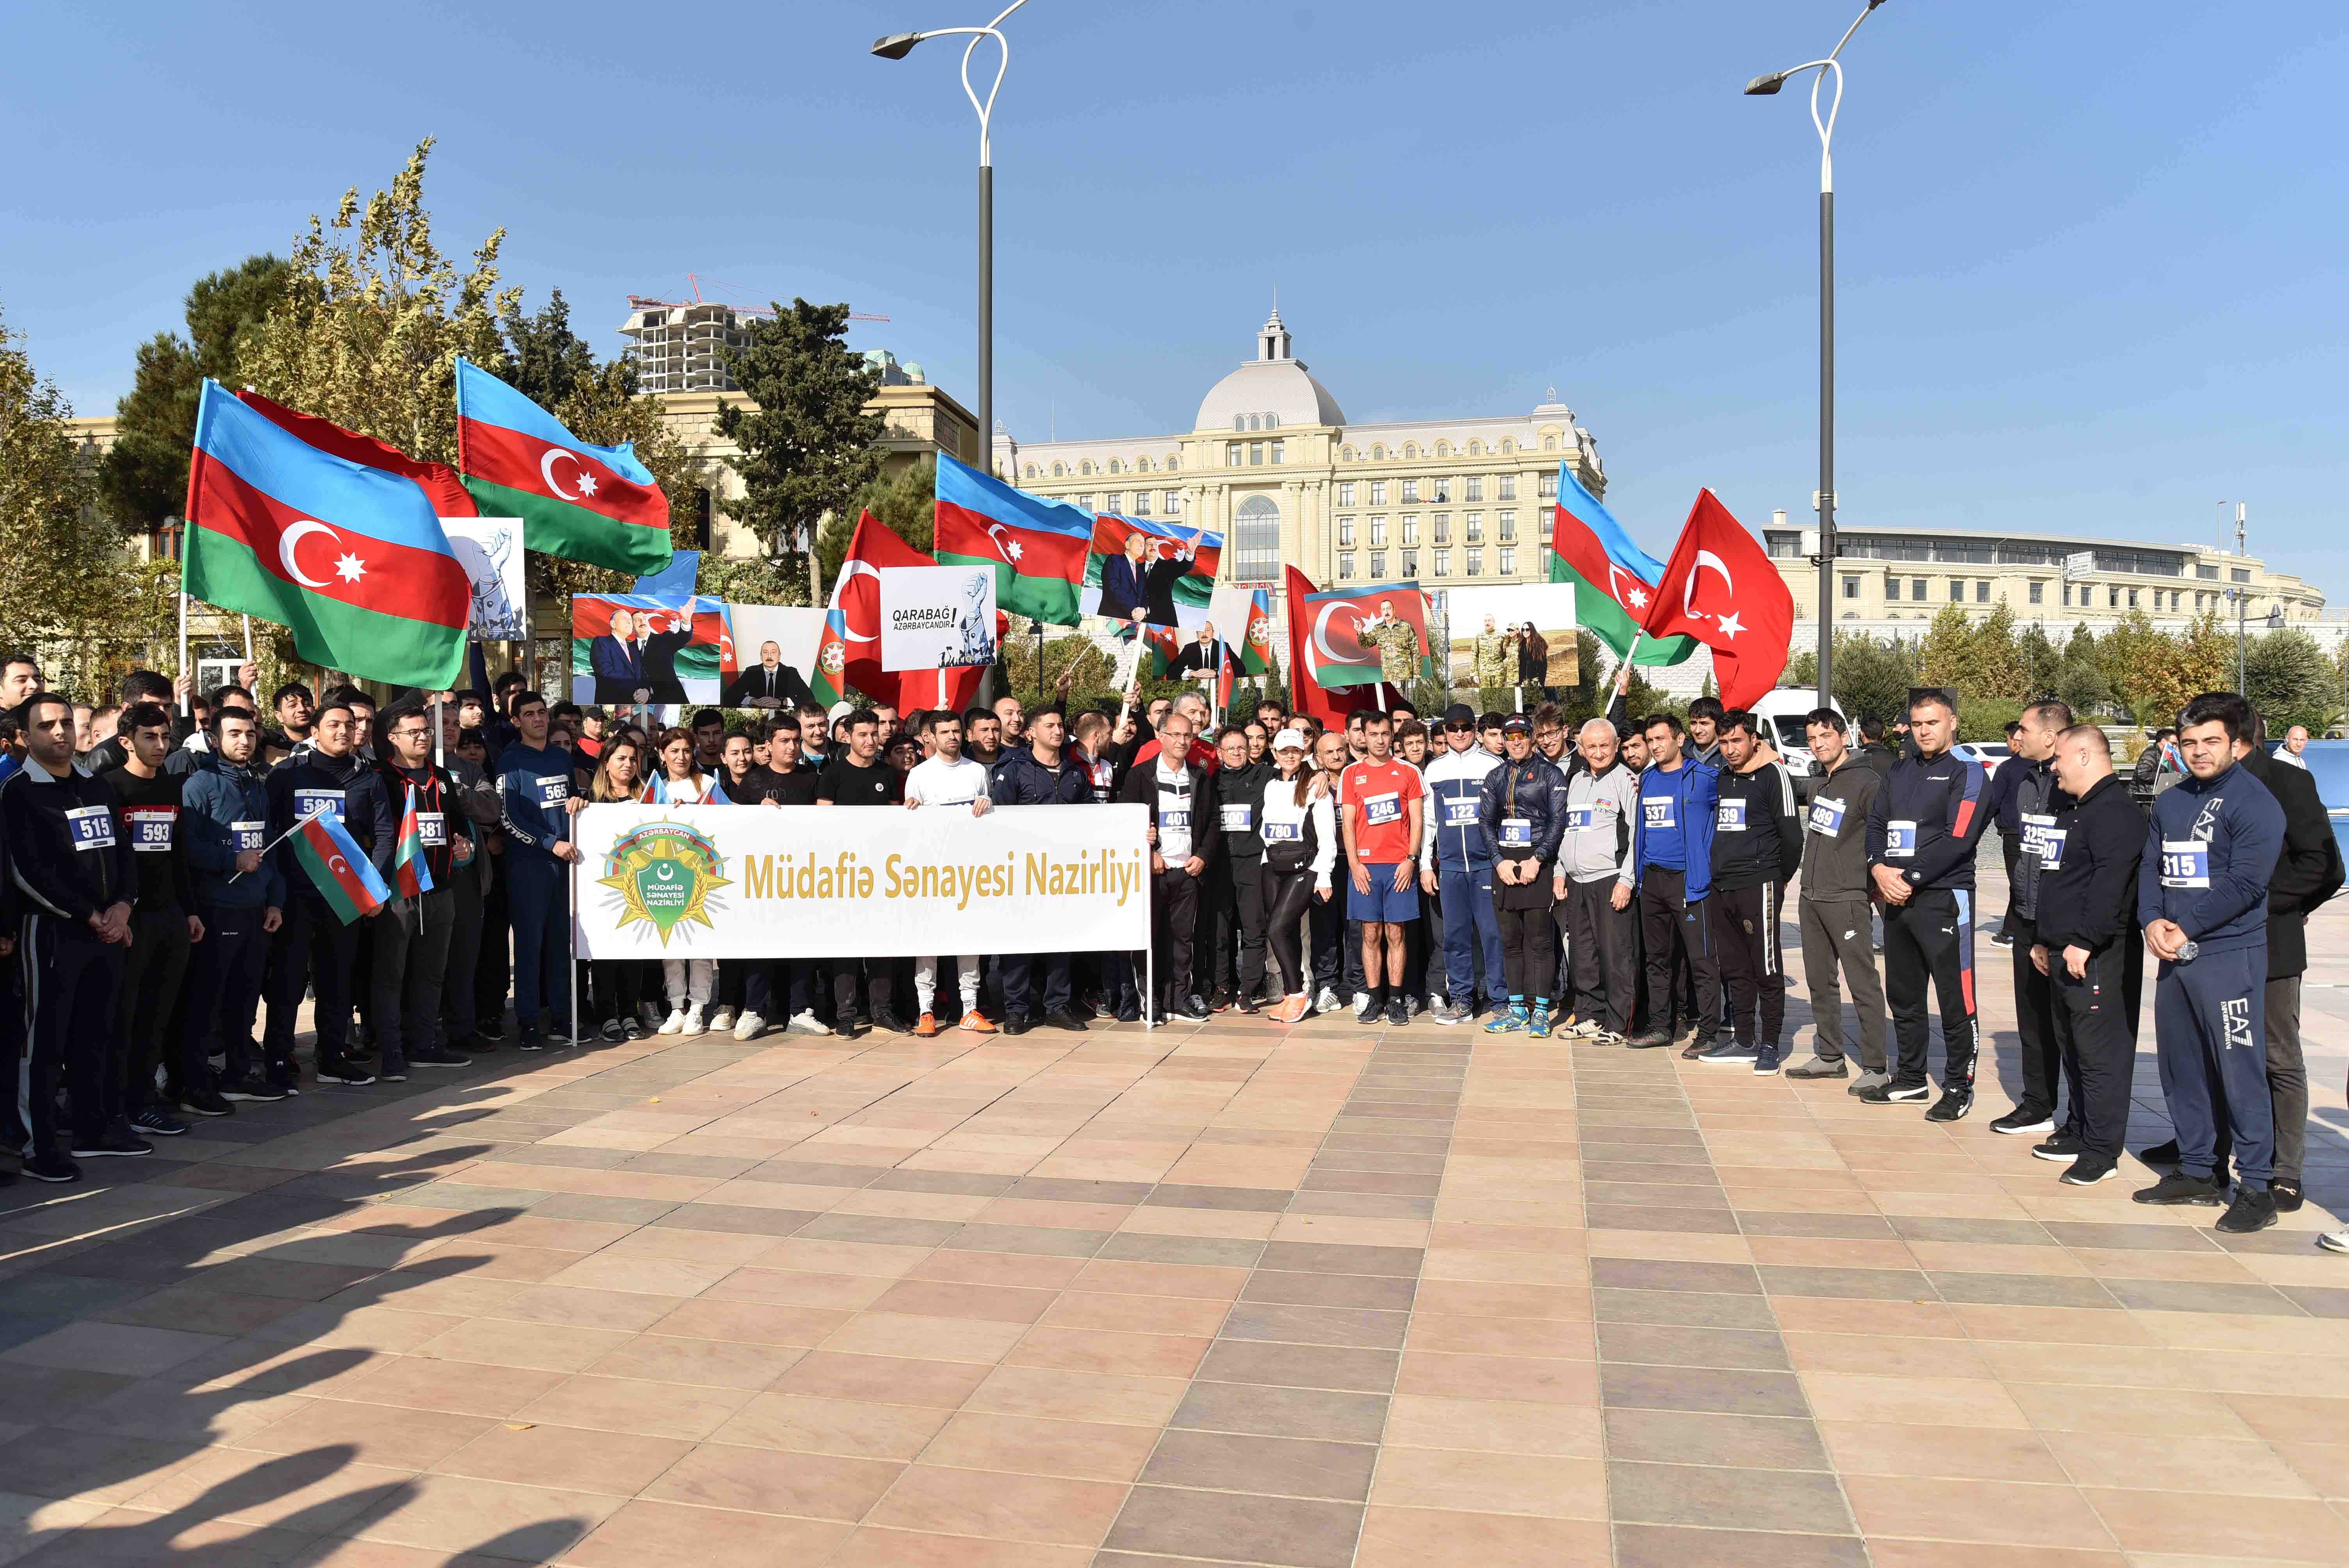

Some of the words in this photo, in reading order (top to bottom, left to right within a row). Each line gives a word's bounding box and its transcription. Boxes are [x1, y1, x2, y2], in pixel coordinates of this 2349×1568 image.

[893, 605, 950, 622] QARABAĞ
[545, 784, 567, 800] 565
[303, 798, 336, 813] 580
[1371, 801, 1395, 818] 246
[1450, 804, 1475, 819] 122
[1645, 805, 1666, 820] 537
[1165, 812, 1188, 826] 401
[1568, 812, 1581, 826] 34
[1812, 807, 1834, 826] 489
[80, 818, 110, 838] 515
[143, 823, 169, 841] 593
[418, 822, 441, 837] 581
[638, 828, 690, 840] AZƏRBAYCAN
[1269, 825, 1291, 838] 780
[1505, 827, 1520, 841] 56
[2023, 825, 2046, 845] 325
[241, 832, 263, 849] 589
[2163, 855, 2196, 876] 315
[745, 852, 874, 898] Müdafiə
[885, 852, 1014, 910] Sənayesi
[1026, 849, 1140, 906] Nazirliyi
[2228, 998, 2253, 1046] EA7
